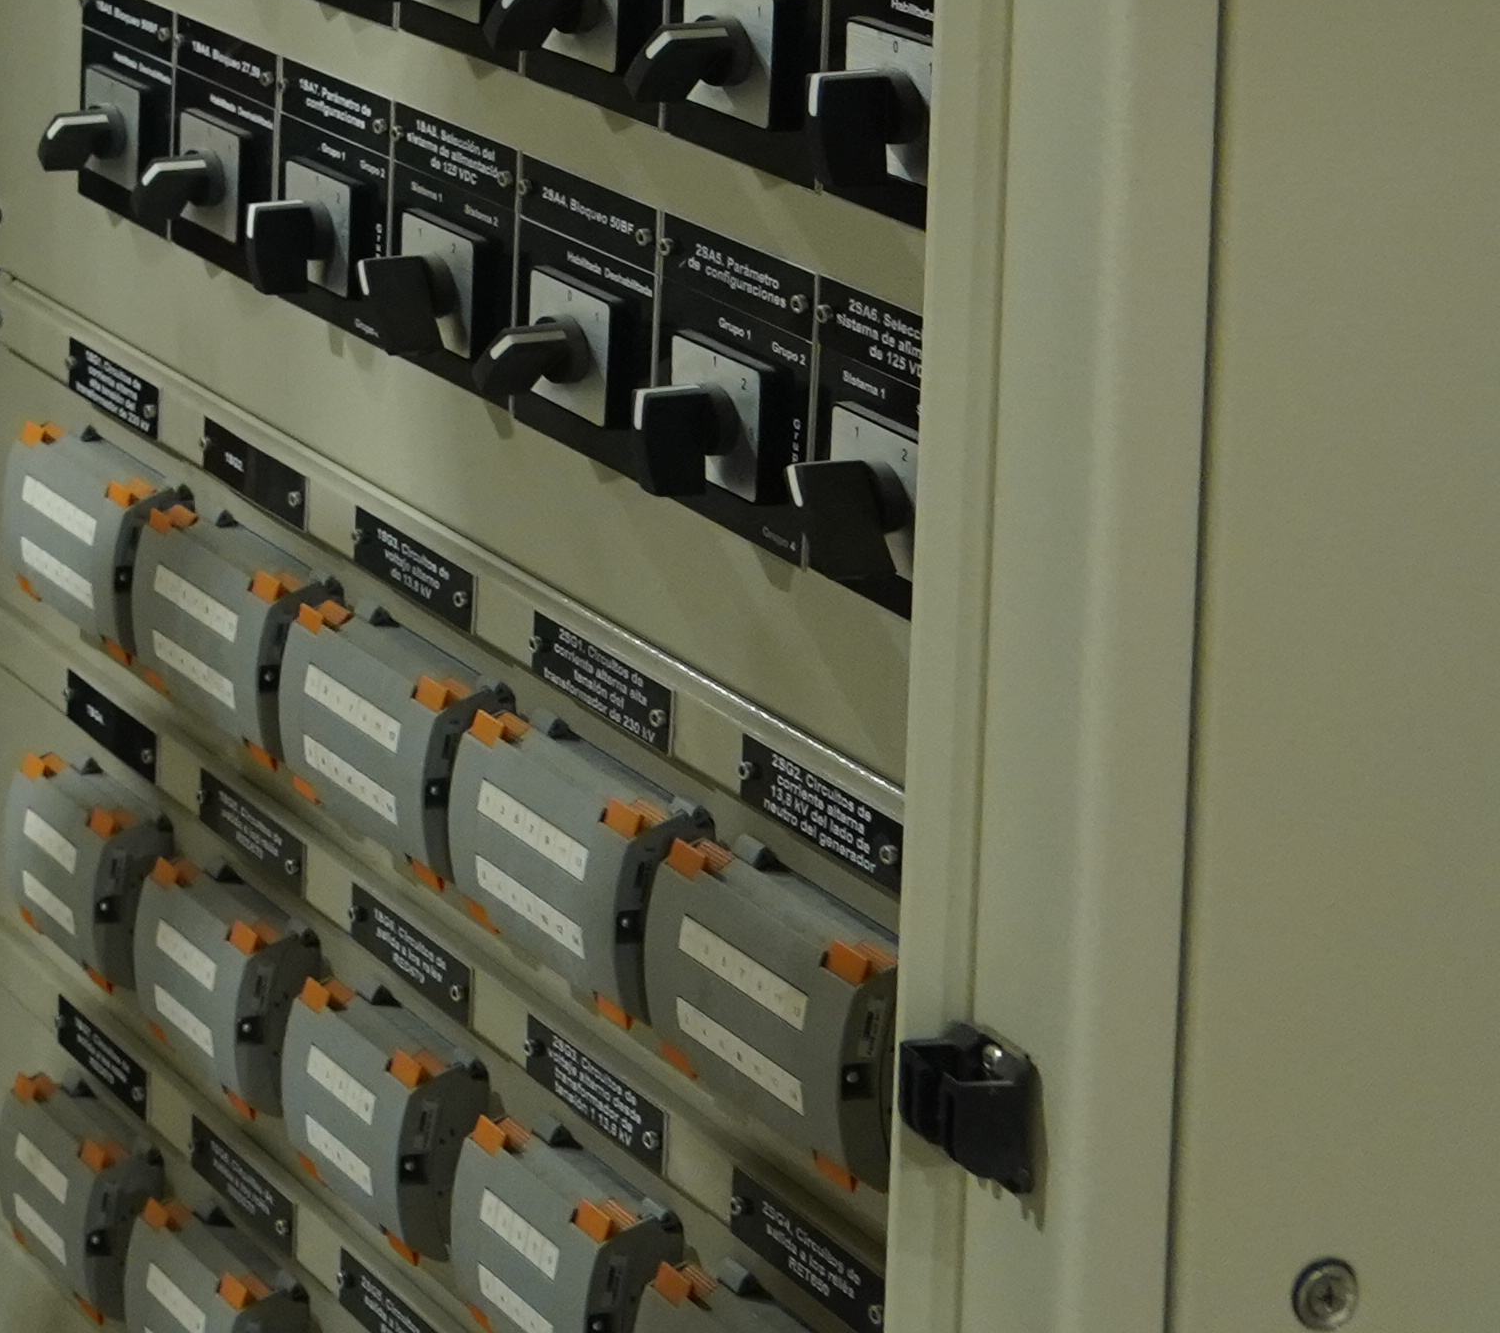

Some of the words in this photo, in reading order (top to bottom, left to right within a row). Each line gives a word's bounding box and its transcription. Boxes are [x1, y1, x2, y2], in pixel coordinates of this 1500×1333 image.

[569, 197, 609, 226] Bloqueo
[695, 242, 725, 269] 2SA5.
[688, 256, 700, 271] de
[704, 265, 787, 310] configuraciones
[718, 316, 745, 339] Grupo
[835, 312, 880, 341] sistema
[880, 329, 897, 348] de
[771, 340, 799, 363] Grupo
[868, 344, 885, 362] de
[885, 350, 908, 371] 125
[841, 369, 880, 397] Sistema
[587, 644, 630, 681] Circuitos
[776, 773, 826, 812] corriente
[826, 802, 867, 837] alterna
[804, 772, 856, 814] Circuitos
[856, 804, 873, 824] de
[763, 796, 799, 828] neutro
[799, 819, 818, 840] del
[817, 830, 878, 875] generador
[793, 797, 811, 818] kV
[810, 809, 828, 830] del
[828, 818, 855, 846] lado
[855, 836, 872, 856] de
